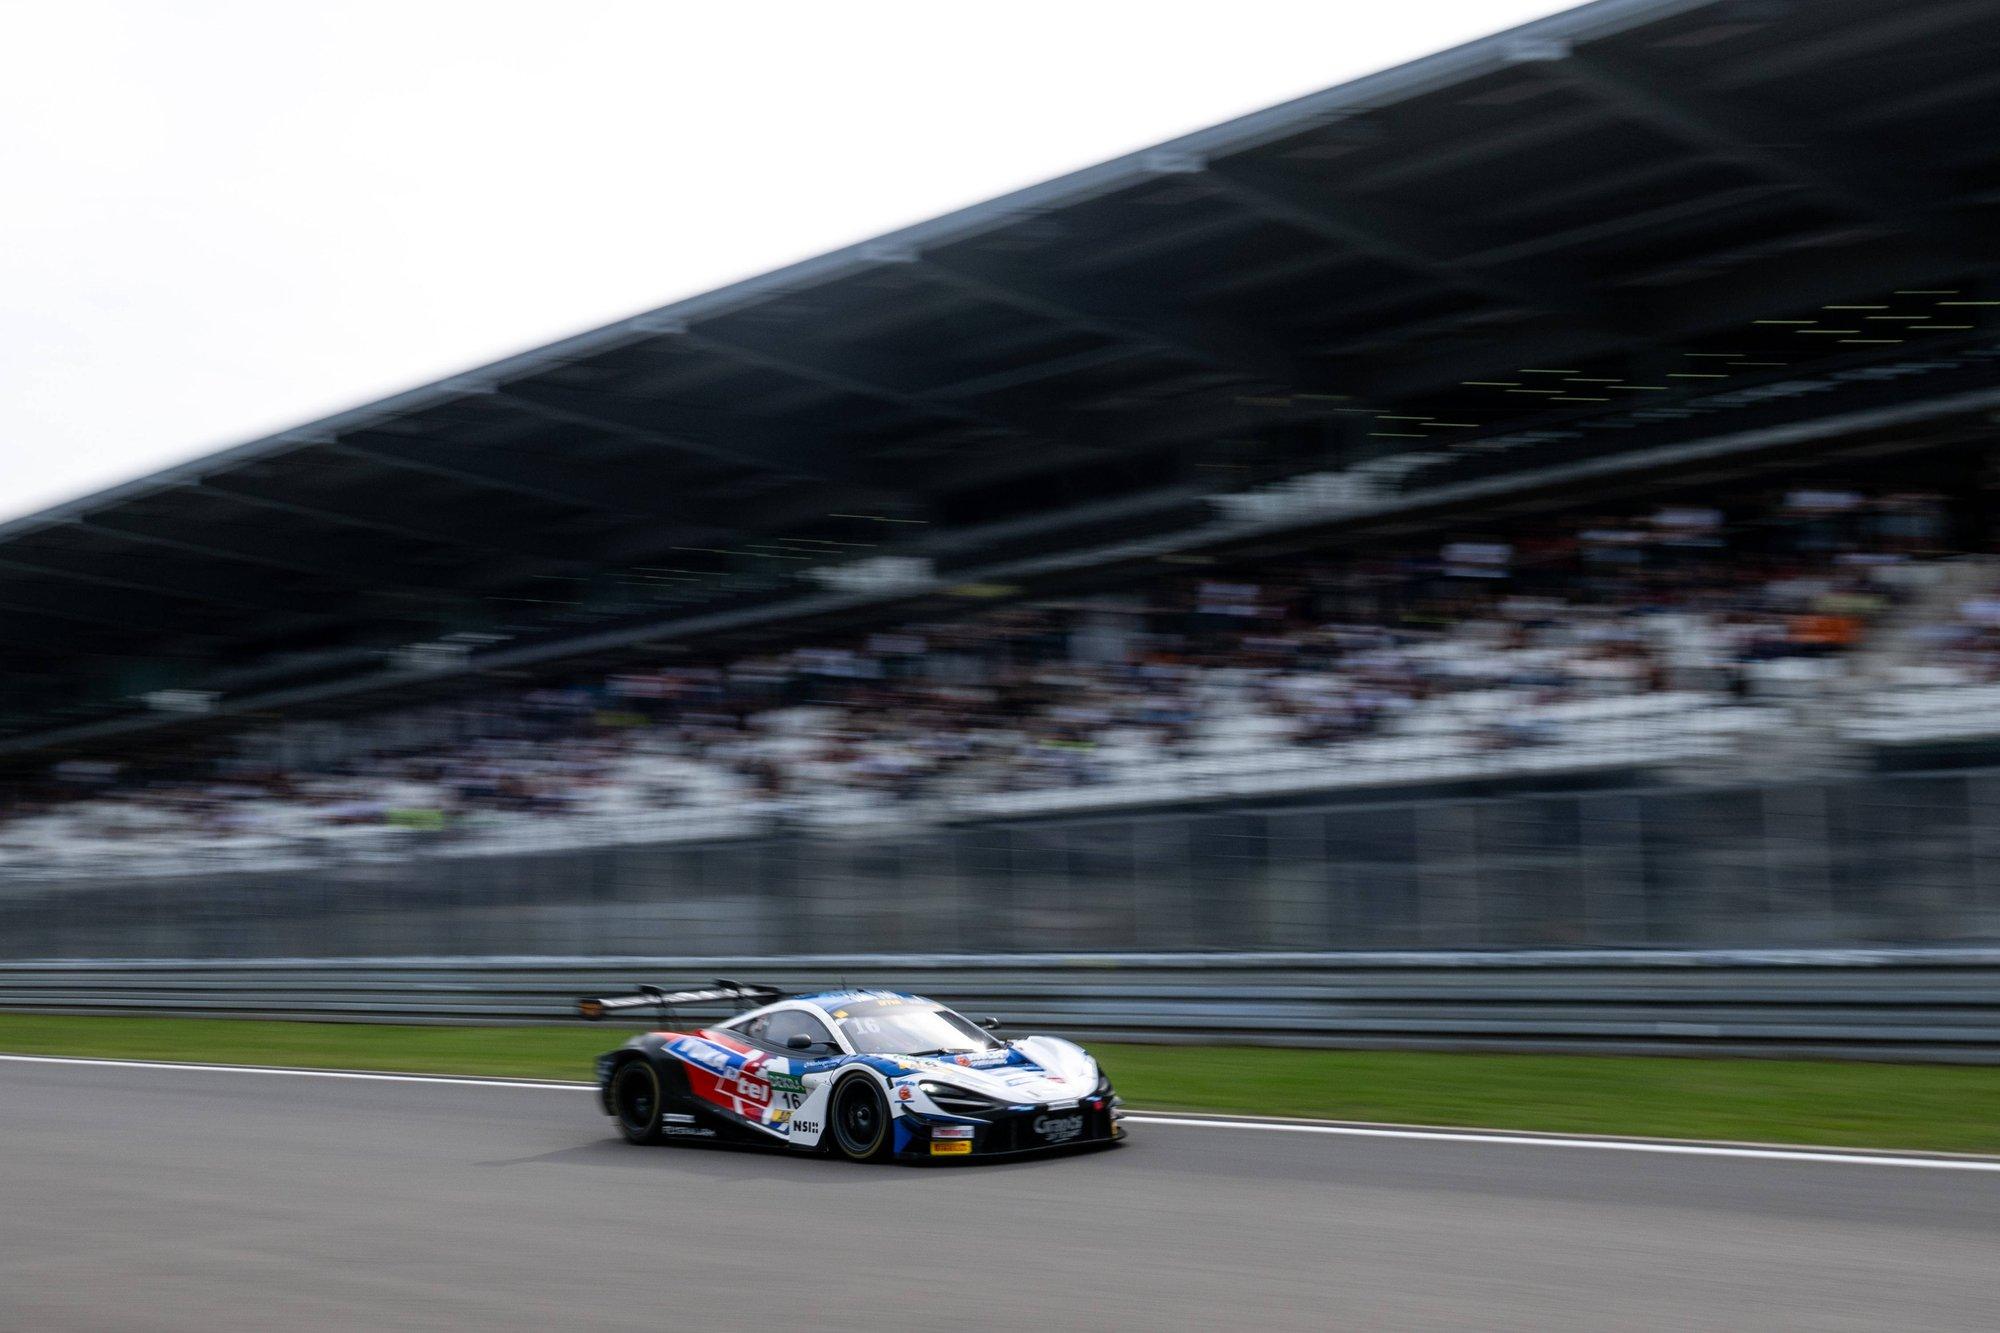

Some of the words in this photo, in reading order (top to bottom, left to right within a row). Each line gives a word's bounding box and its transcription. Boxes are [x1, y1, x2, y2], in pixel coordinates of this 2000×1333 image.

[854, 1016, 881, 1035] 16
[738, 1077, 770, 1102] tel
[782, 1092, 801, 1110] 16
